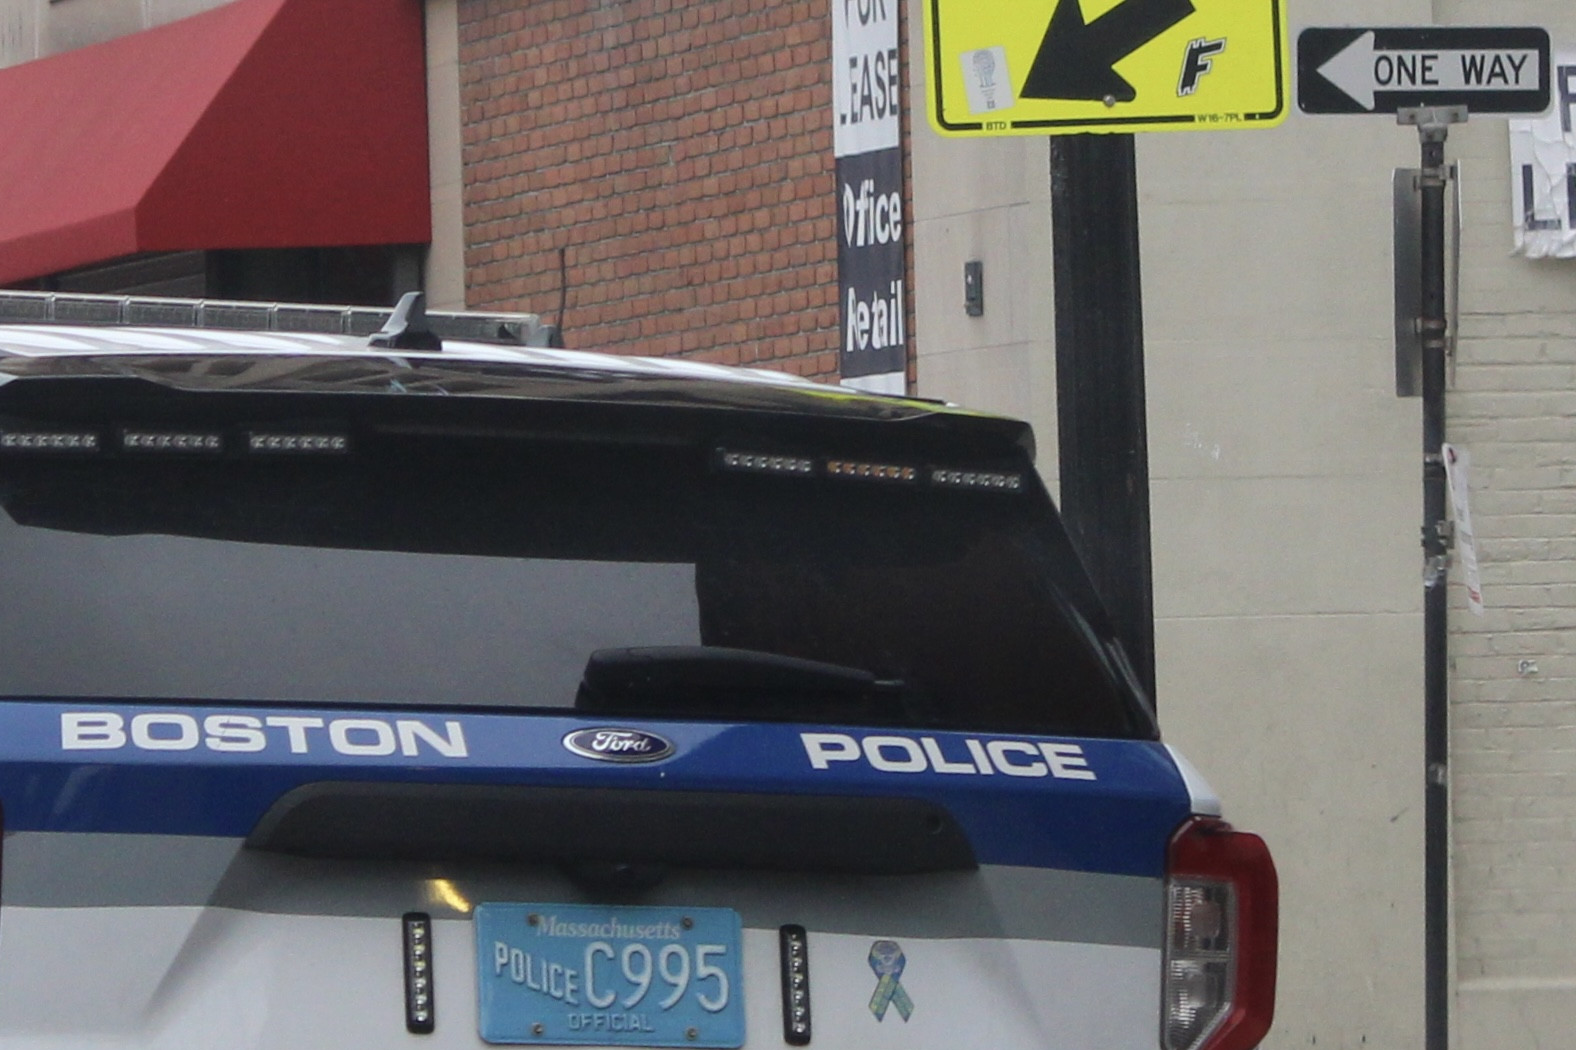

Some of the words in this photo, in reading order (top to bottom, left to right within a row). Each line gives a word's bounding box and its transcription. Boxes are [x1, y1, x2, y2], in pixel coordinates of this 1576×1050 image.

[839, 48, 898, 125] EASE
[1375, 54, 1439, 86] ONE
[1461, 54, 1528, 86] WAY
[846, 279, 904, 352] Retail
[60, 712, 468, 758] BOSTON
[800, 733, 1097, 780] POLICE
[592, 731, 651, 752] Ford
[535, 915, 682, 940] Massachusetts
[495, 941, 579, 1006] POLICE
[584, 941, 730, 1013] C995
[568, 1013, 655, 1033] OFFICIAL
